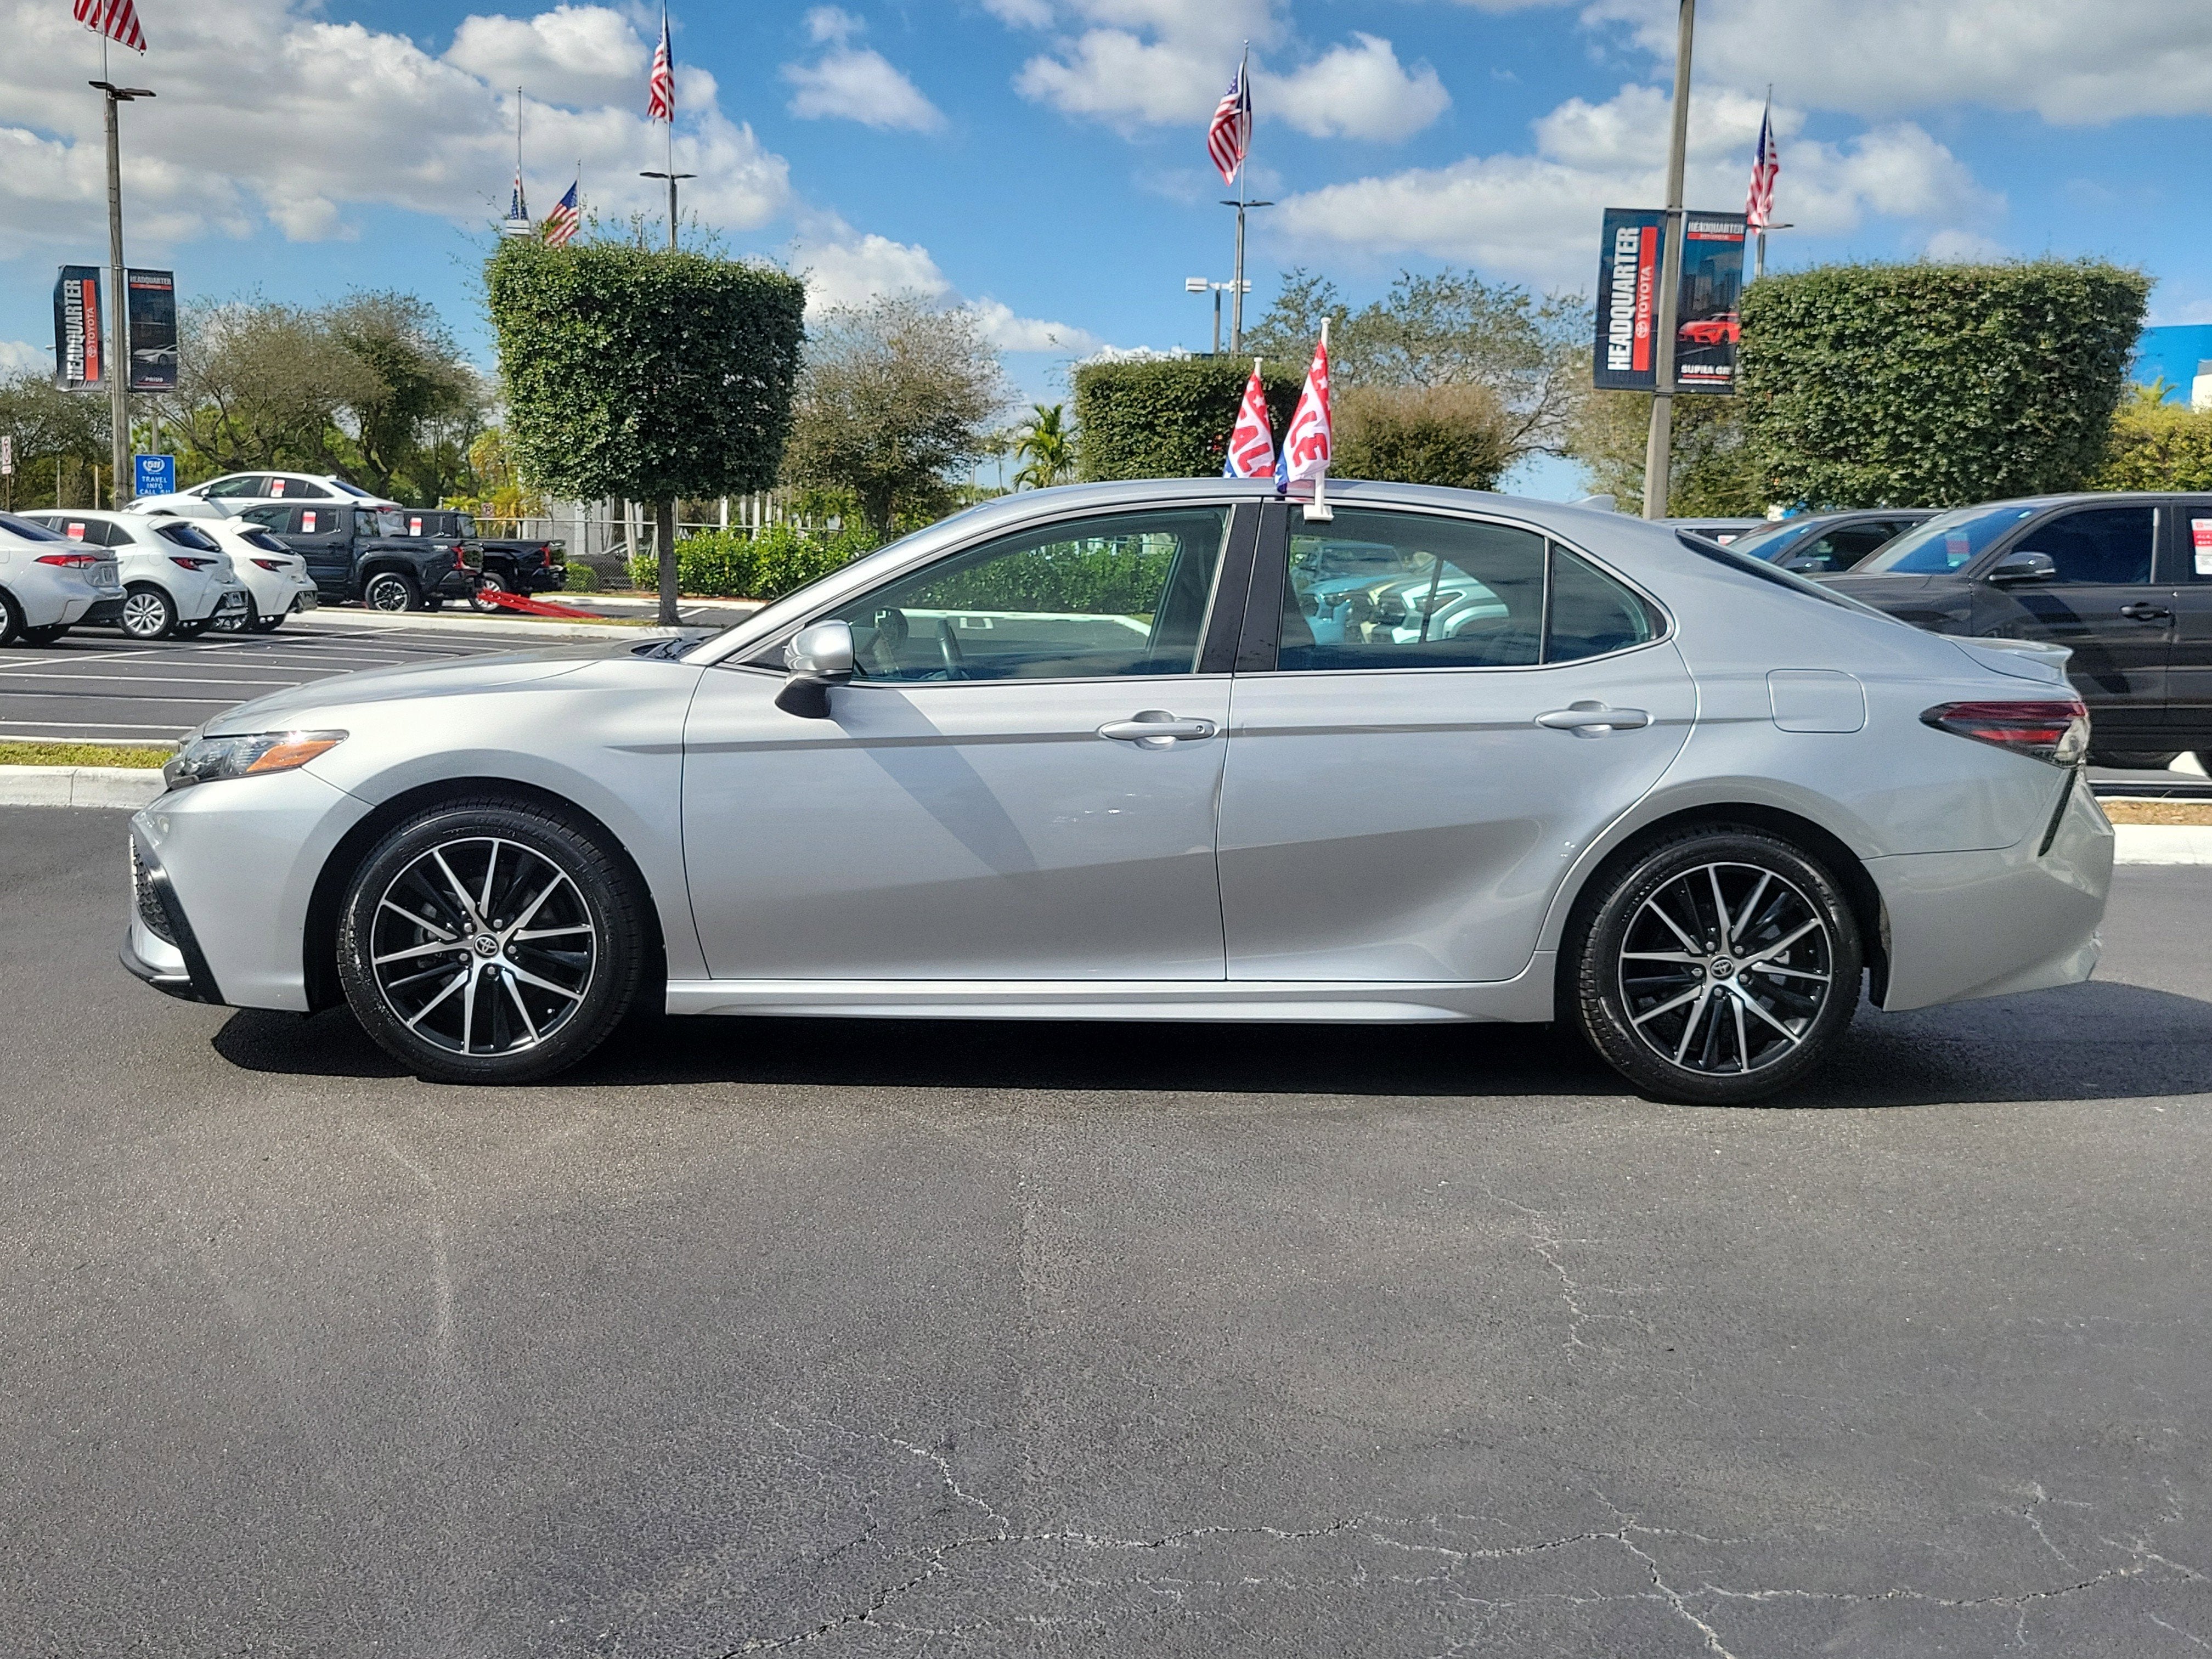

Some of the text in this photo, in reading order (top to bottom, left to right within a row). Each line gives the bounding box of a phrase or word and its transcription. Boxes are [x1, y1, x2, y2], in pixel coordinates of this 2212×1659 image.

[1607, 227, 1640, 370] HEADQUARTER
[1638, 265, 1653, 320] TOYOTA
[64, 279, 86, 380] HEADQUARTER
[87, 307, 96, 344] TOYOTA
[1681, 364, 1714, 374] SUPRA
